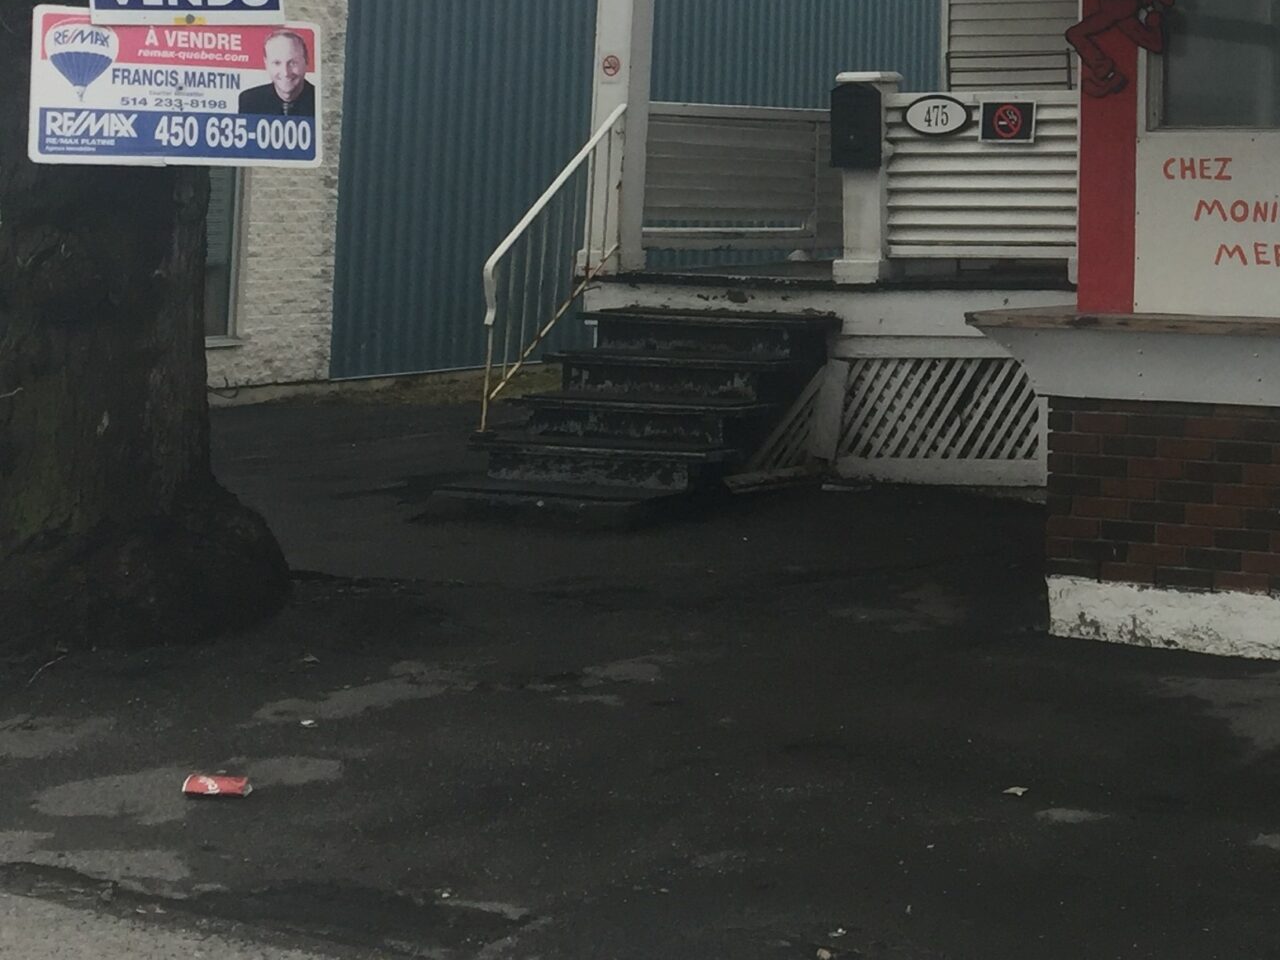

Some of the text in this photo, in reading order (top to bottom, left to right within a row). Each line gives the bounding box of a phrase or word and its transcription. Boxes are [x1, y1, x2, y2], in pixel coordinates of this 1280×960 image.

[53, 28, 111, 49] RE/MAX
[144, 25, 242, 51] À VENDRE
[137, 48, 249, 63] remax-quebec.com
[112, 67, 241, 91] FRANCIS MARTIN
[120, 96, 228, 110] 514 233-8198
[45, 110, 139, 139] RE/MAX
[923, 105, 950, 128] 475
[154, 115, 312, 151] 450 635-0000
[1162, 156, 1233, 181] CHEZ
